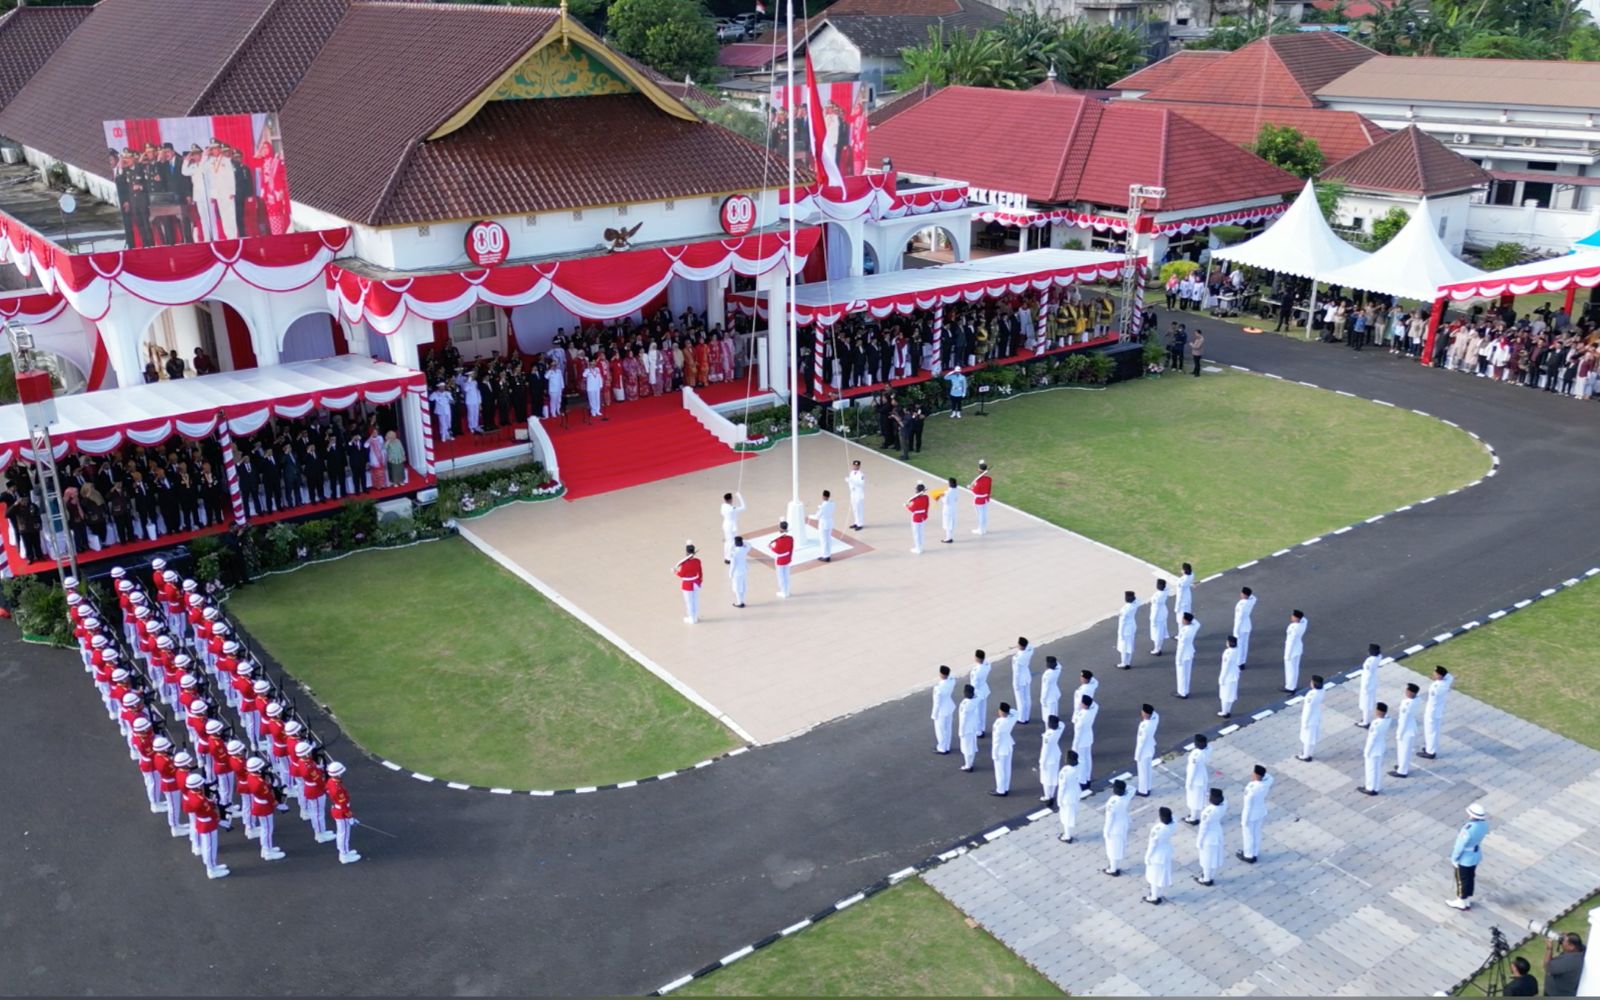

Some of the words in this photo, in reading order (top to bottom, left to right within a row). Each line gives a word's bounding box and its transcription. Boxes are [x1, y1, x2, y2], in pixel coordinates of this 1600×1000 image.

[727, 196, 752, 224] 80
[989, 189, 1028, 210] KEPRI
[473, 223, 503, 254] 80
